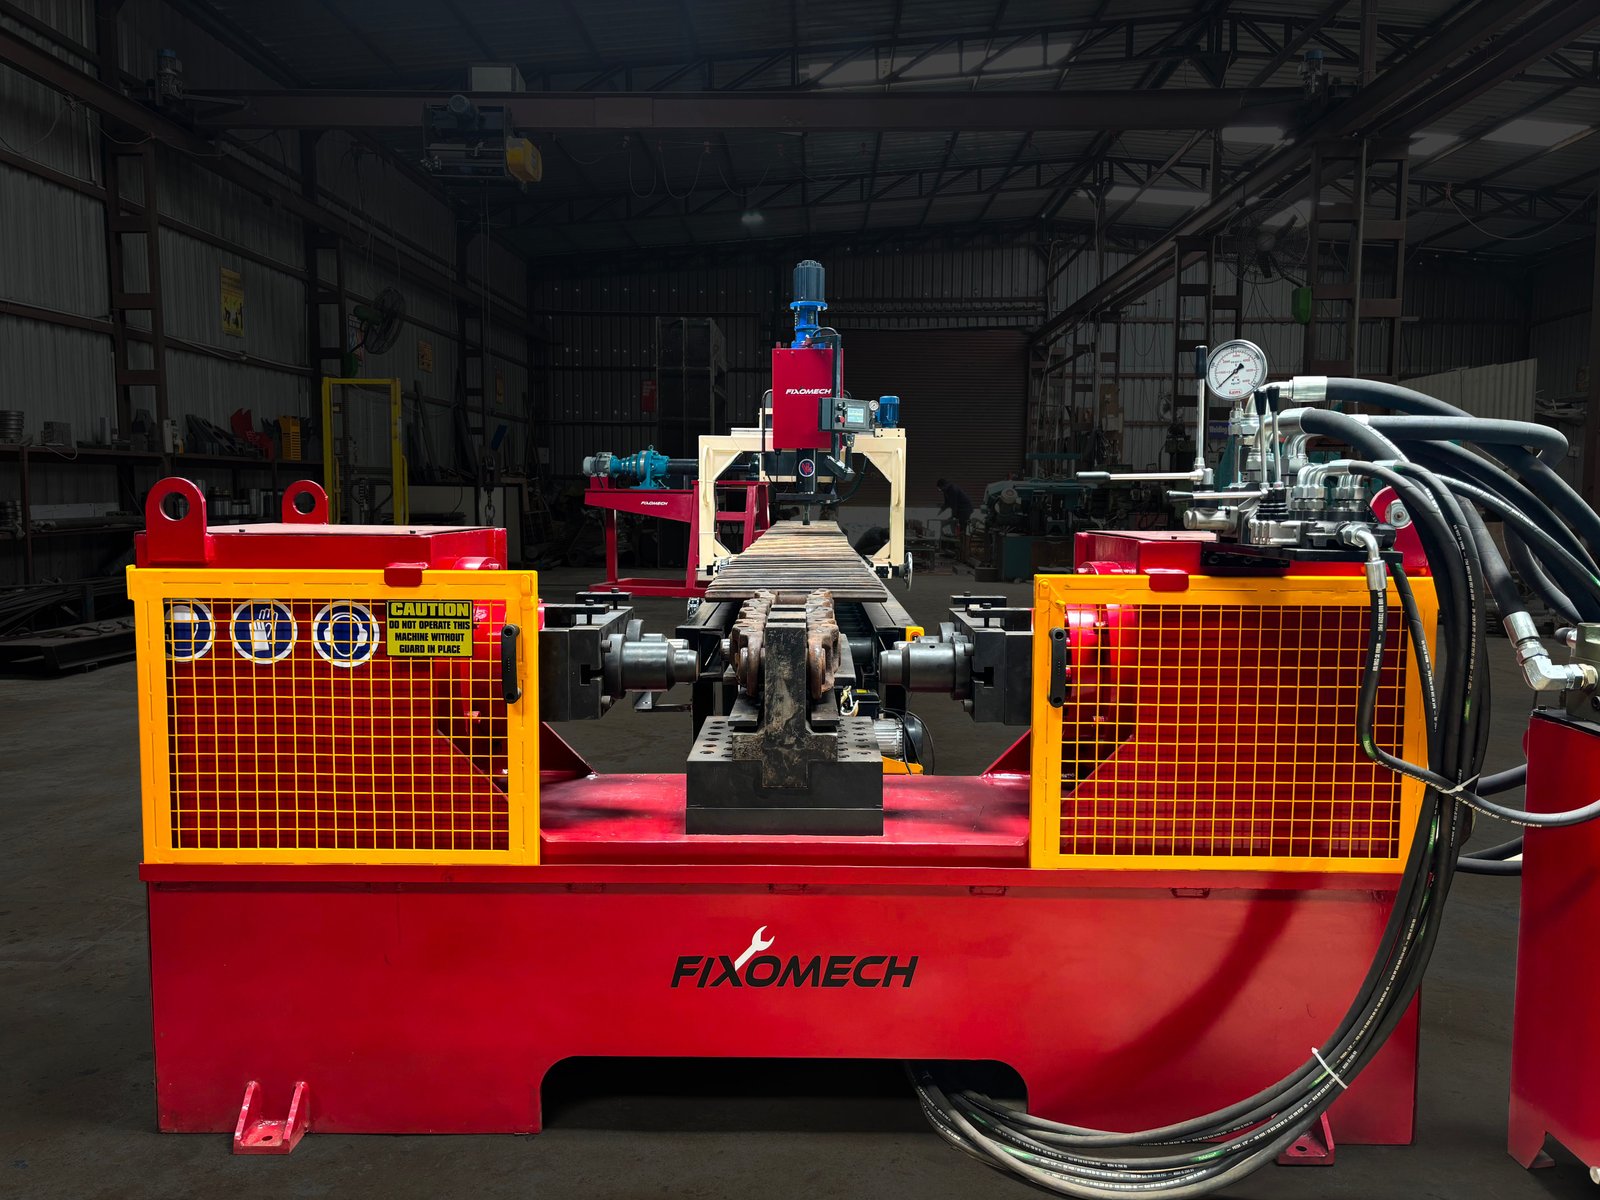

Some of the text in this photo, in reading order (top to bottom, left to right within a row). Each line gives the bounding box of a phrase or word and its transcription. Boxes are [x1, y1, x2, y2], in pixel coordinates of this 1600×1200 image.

[390, 602, 469, 617] CAUTION
[389, 620, 470, 630] DO NOT OPERATE THIS
[395, 632, 465, 642] MACHINE WITHOUT
[399, 644, 461, 654] GUARD IN PLACE
[670, 951, 920, 988] FIXOMECH
